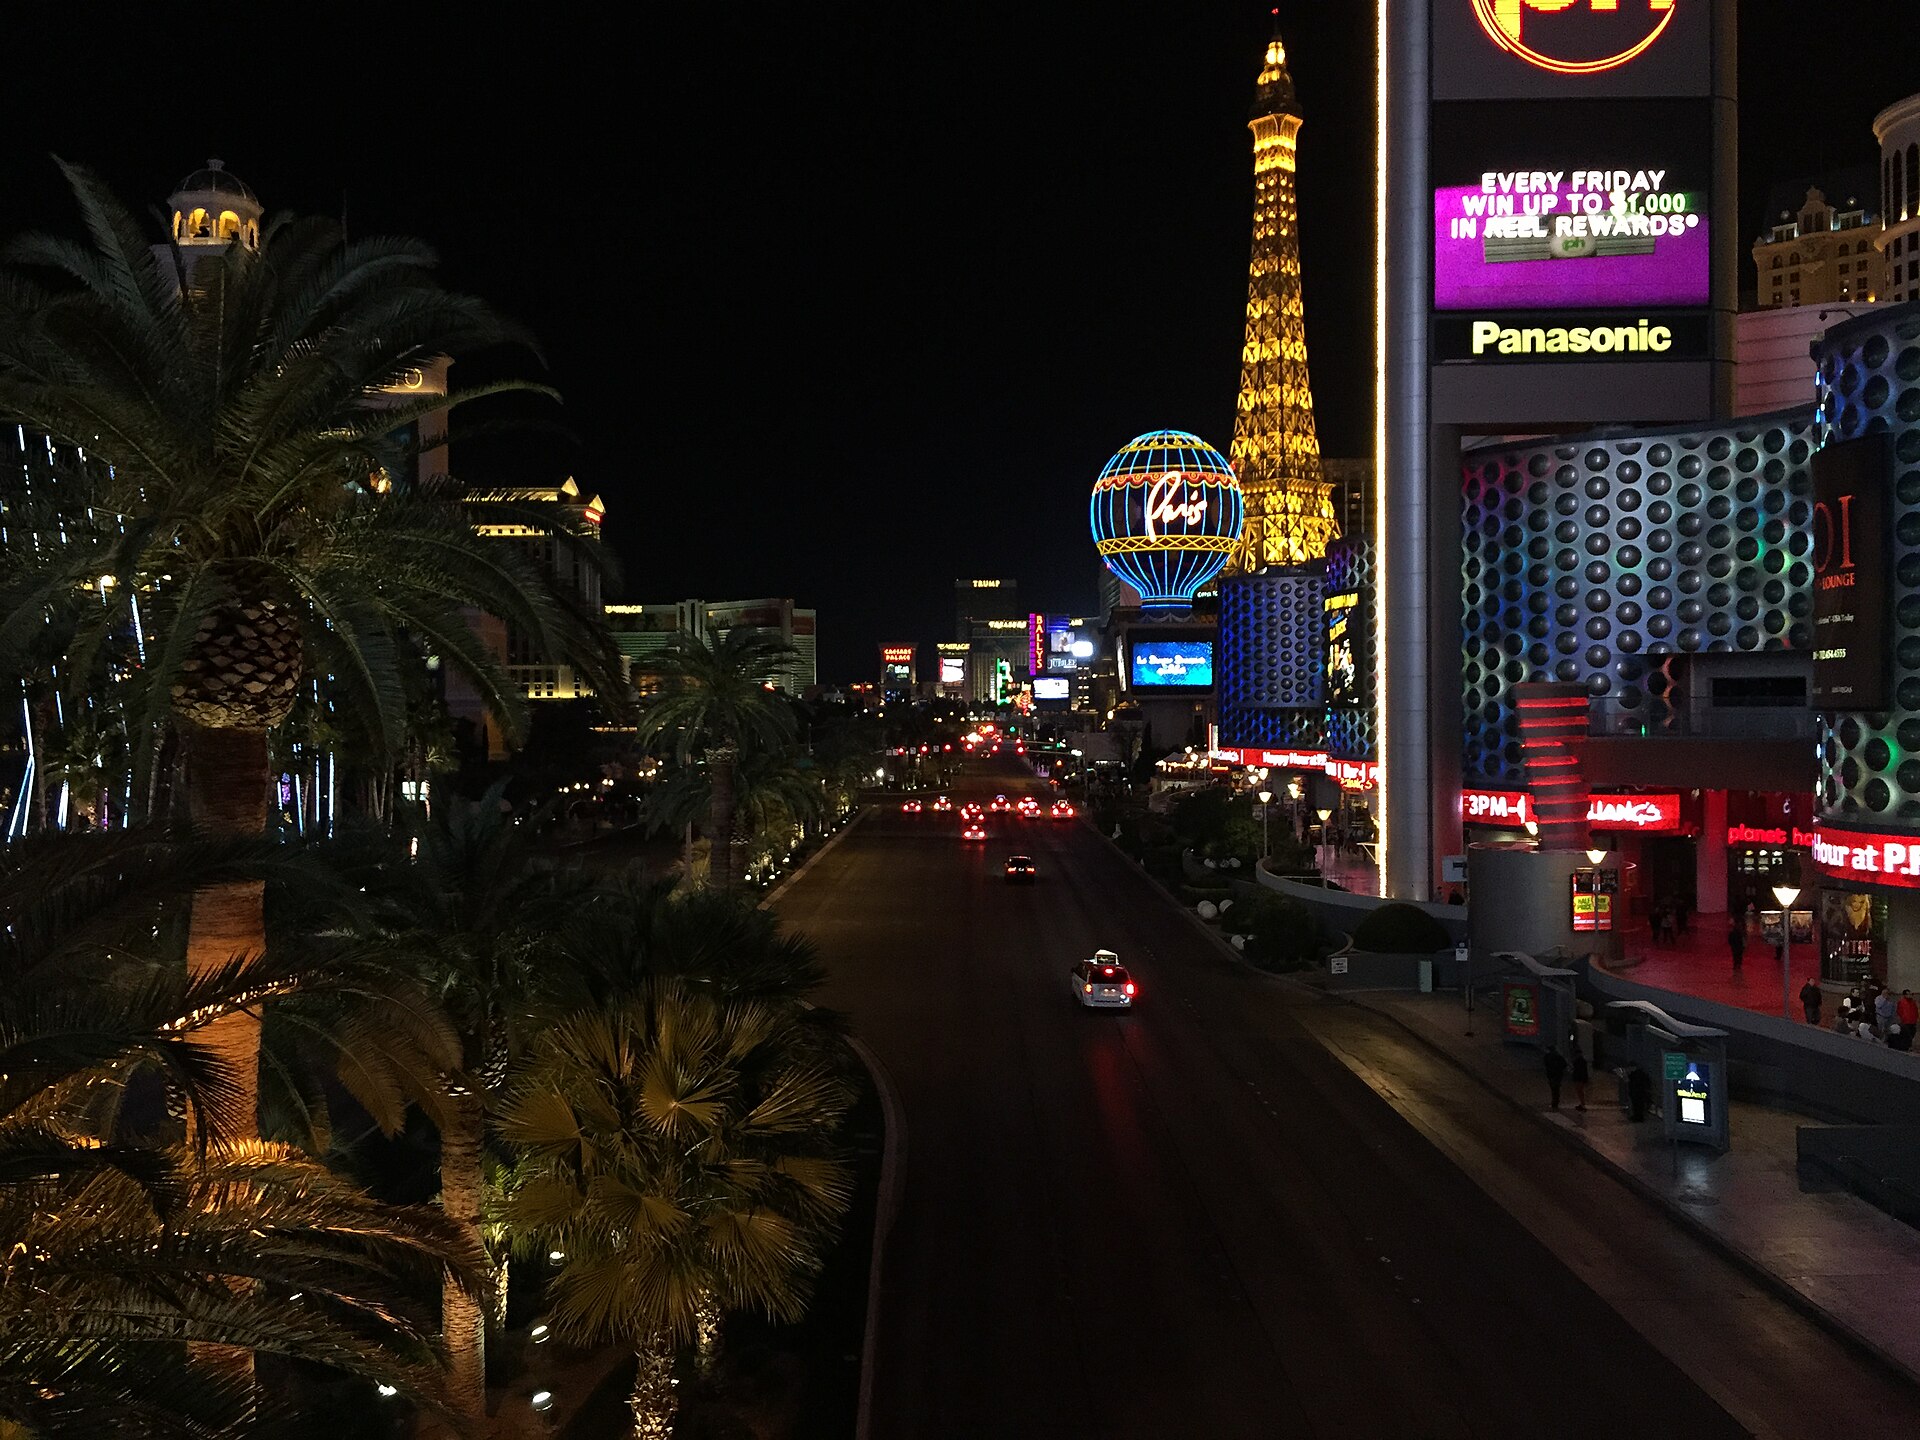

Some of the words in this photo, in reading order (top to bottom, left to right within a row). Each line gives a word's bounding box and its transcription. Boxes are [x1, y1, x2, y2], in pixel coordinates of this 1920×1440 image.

[1481, 171, 1563, 194] EVERY
[1572, 170, 1666, 192] FRIDAY
[1462, 194, 1514, 217] WIN
[1522, 194, 1559, 216] UP
[1566, 193, 1603, 216] TO
[1609, 191, 1686, 216] $1,000
[1451, 217, 1477, 239] IN
[1472, 318, 1672, 354] Panasonic
[1145, 470, 1208, 544] Paris
[972, 579, 1001, 588] TRUMP
[1822, 572, 1856, 590] LOUNGE
[1728, 823, 1787, 845] planet
[1812, 832, 1850, 867] Hour
[1851, 843, 1879, 871] at
